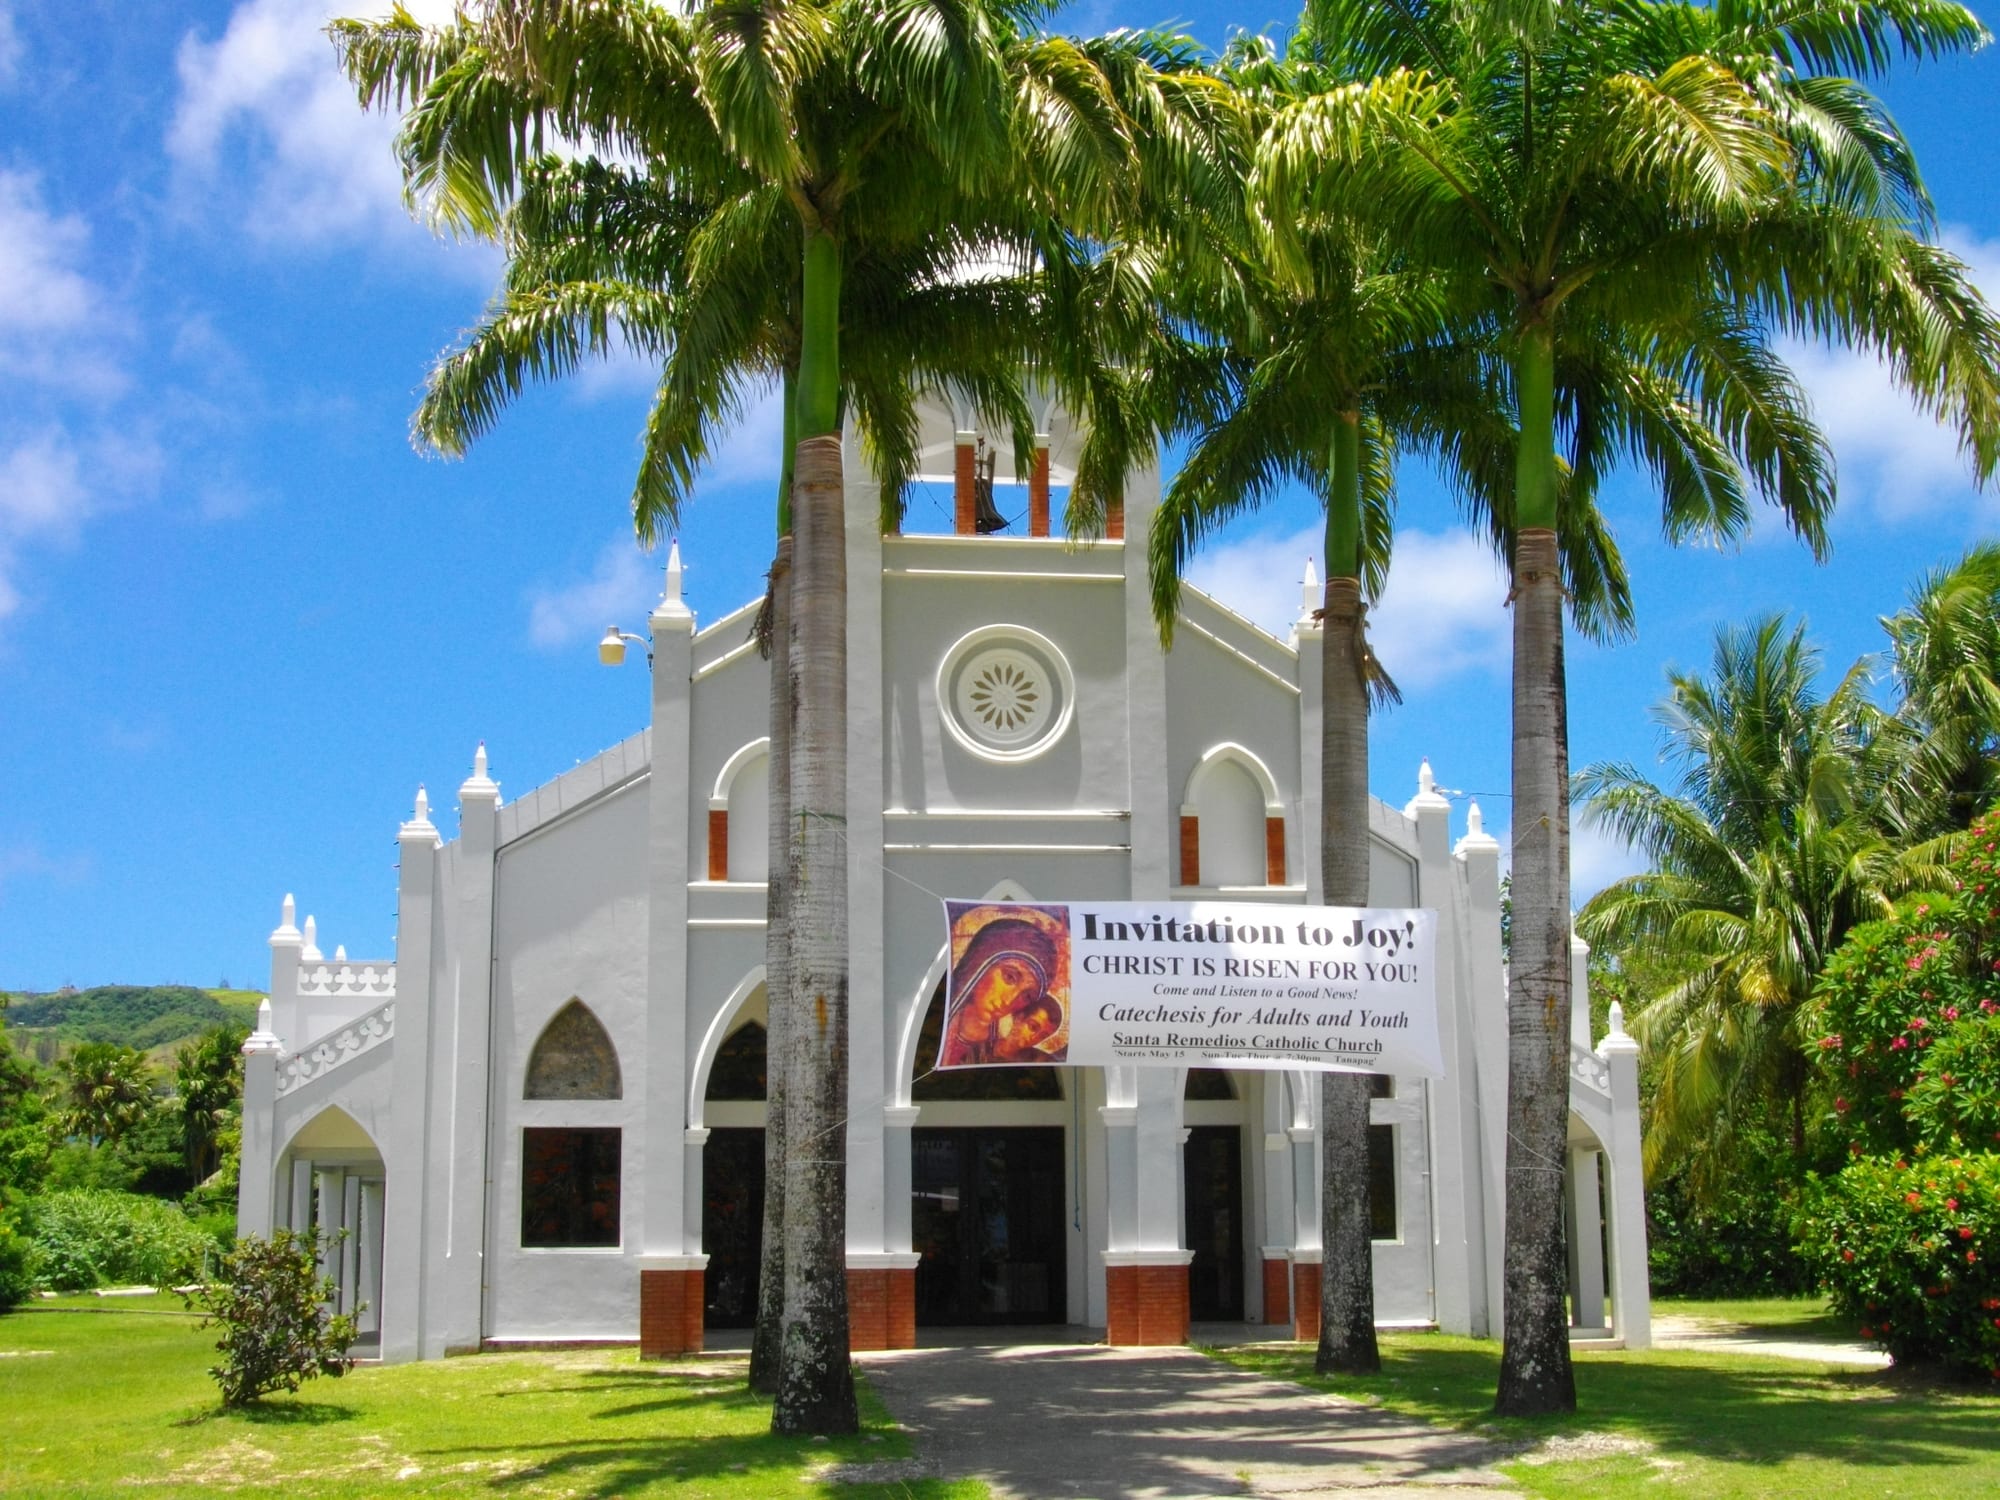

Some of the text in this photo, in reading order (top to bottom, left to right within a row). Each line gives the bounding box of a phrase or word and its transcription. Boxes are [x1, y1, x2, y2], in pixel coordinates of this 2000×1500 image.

[1080, 912, 1414, 958] Invitation to Joy!
[1083, 954, 1417, 983] CHRIST IS RISEN FOR YOU!
[1153, 983, 1358, 1000] Come and Listen to a Good News!
[1098, 1002, 1409, 1029] Catechesis for Adults and Youth
[1112, 1031, 1383, 1053] Santa Remedios Catholic Church
[1150, 1050, 1169, 1060] May
[1174, 1050, 1185, 1058] 15
